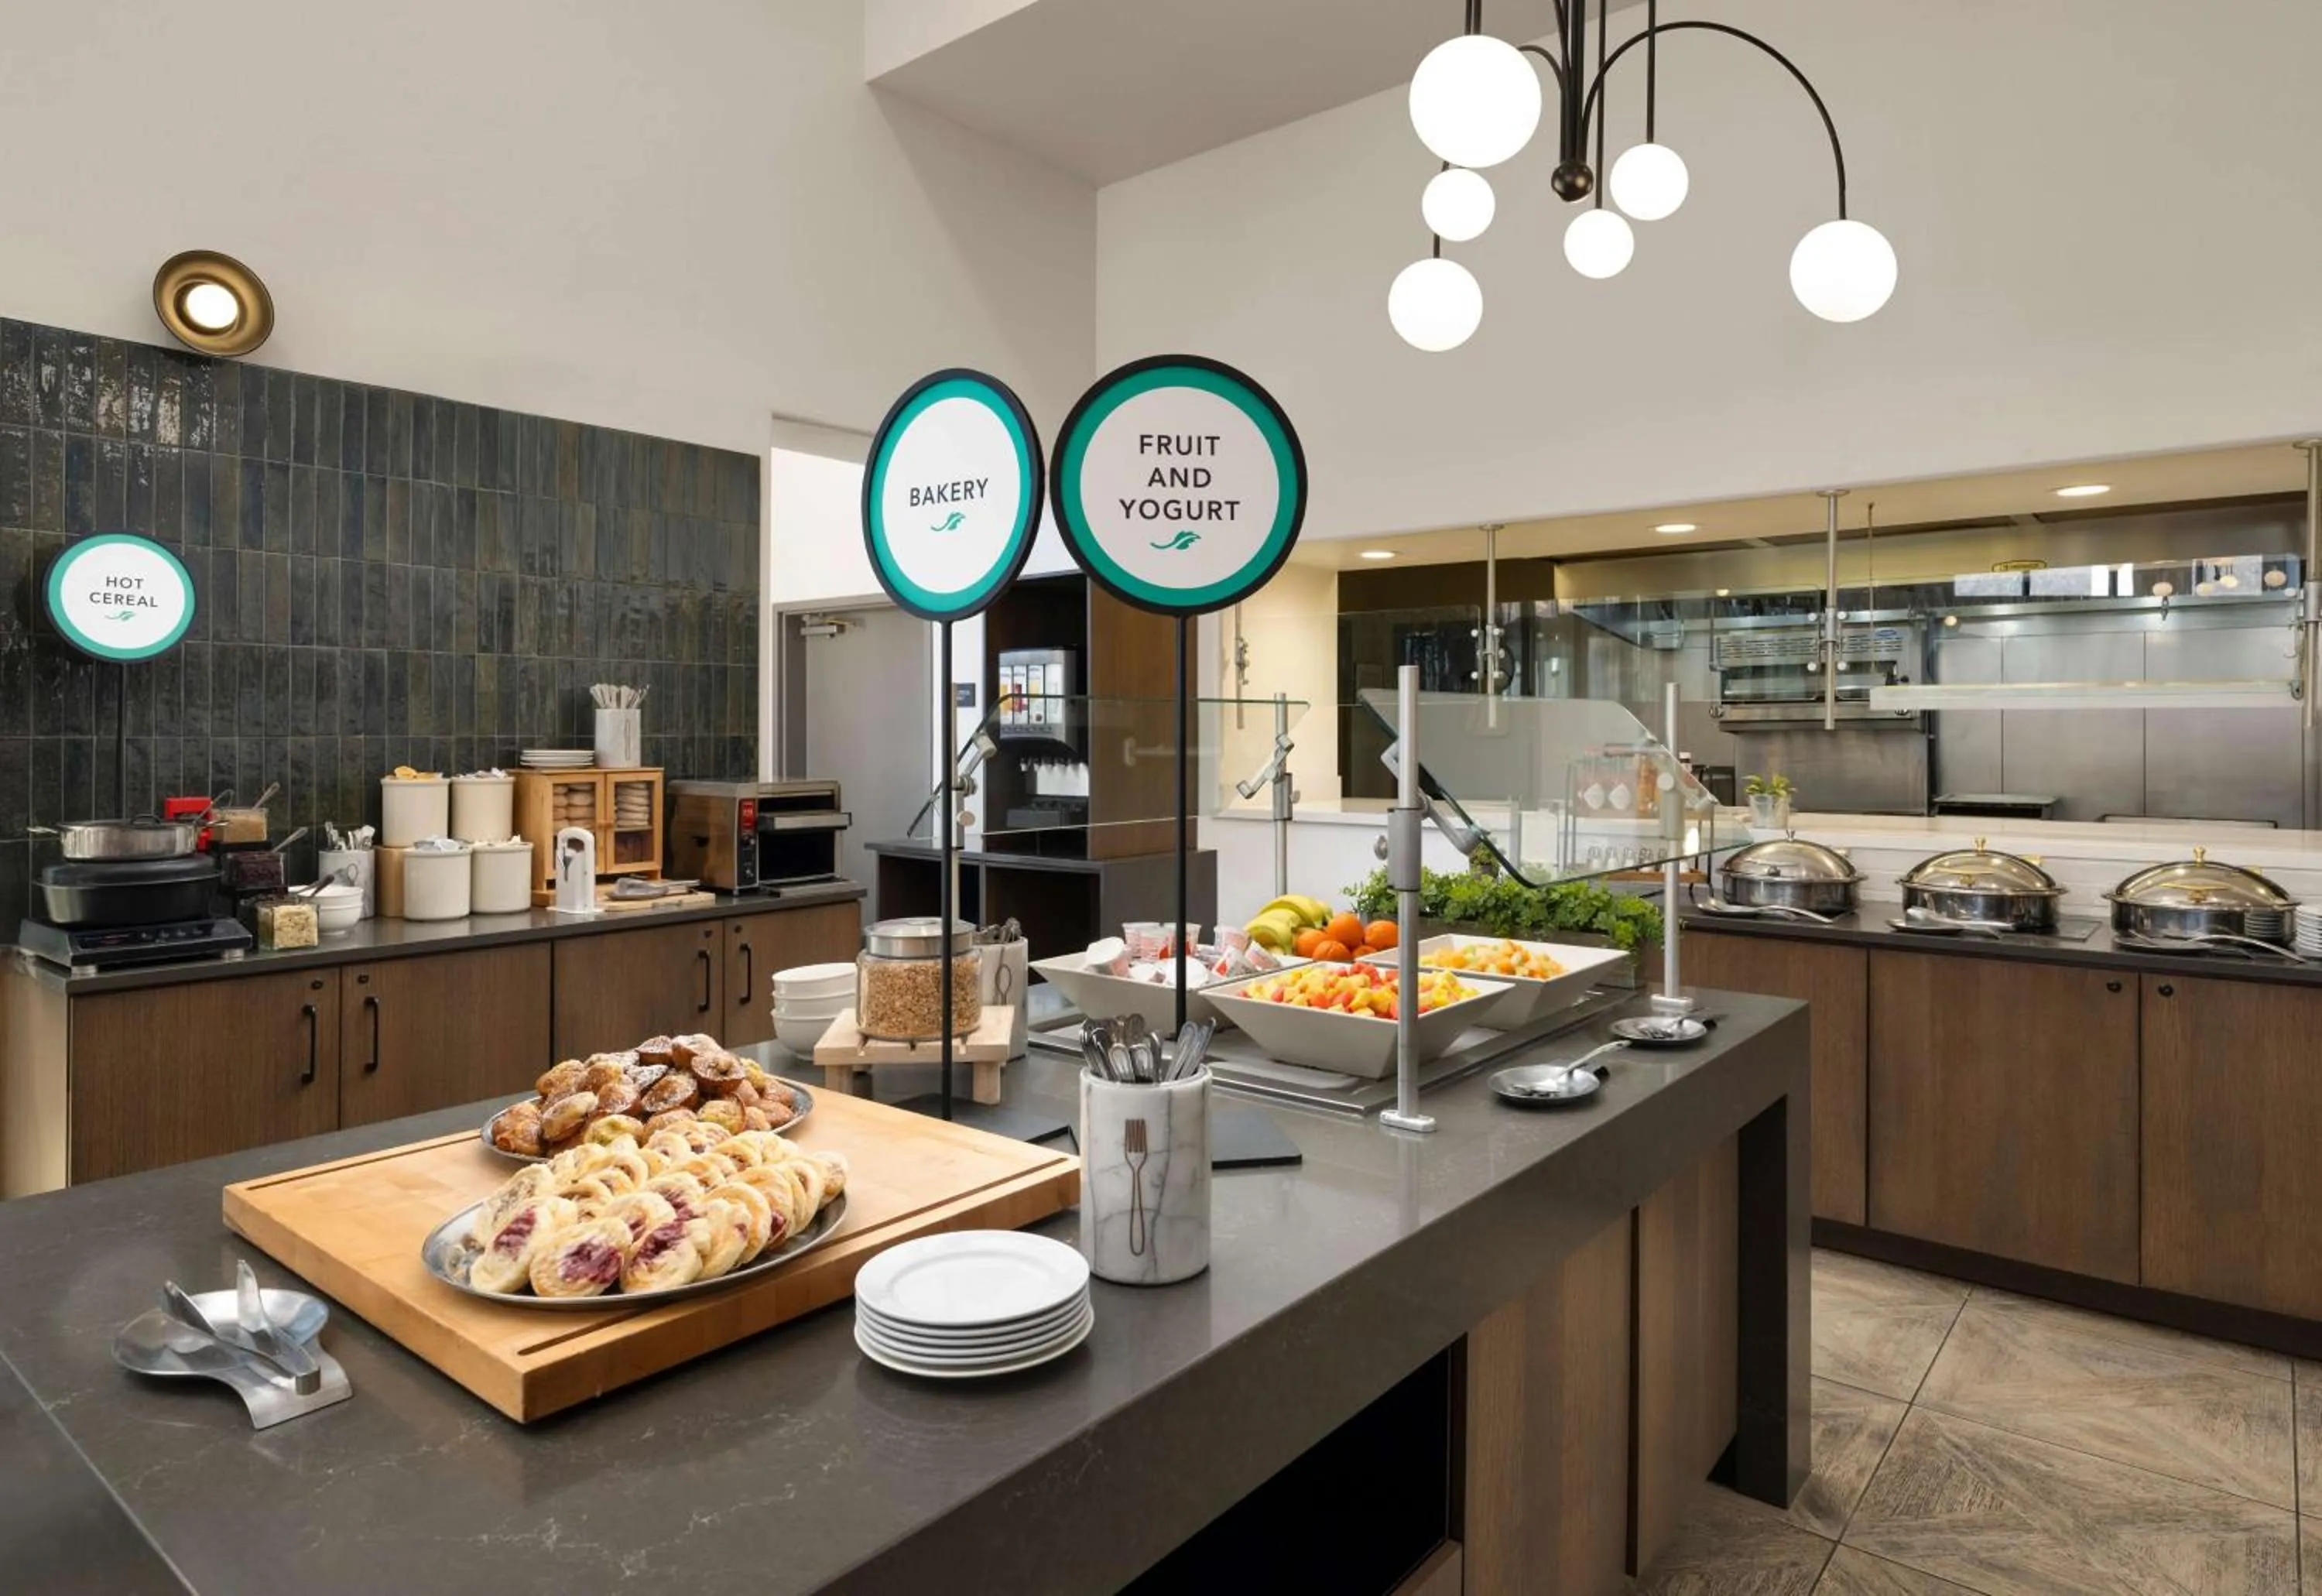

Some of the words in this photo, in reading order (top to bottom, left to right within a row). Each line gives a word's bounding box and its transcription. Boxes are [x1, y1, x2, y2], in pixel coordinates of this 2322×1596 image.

[1139, 433, 1221, 457] FRUIT
[1147, 467, 1212, 488] AND
[909, 478, 988, 507] BAKERY
[1118, 498, 1241, 521] YOGURT
[105, 576, 144, 590] HOT
[89, 591, 159, 608] CEREAL
